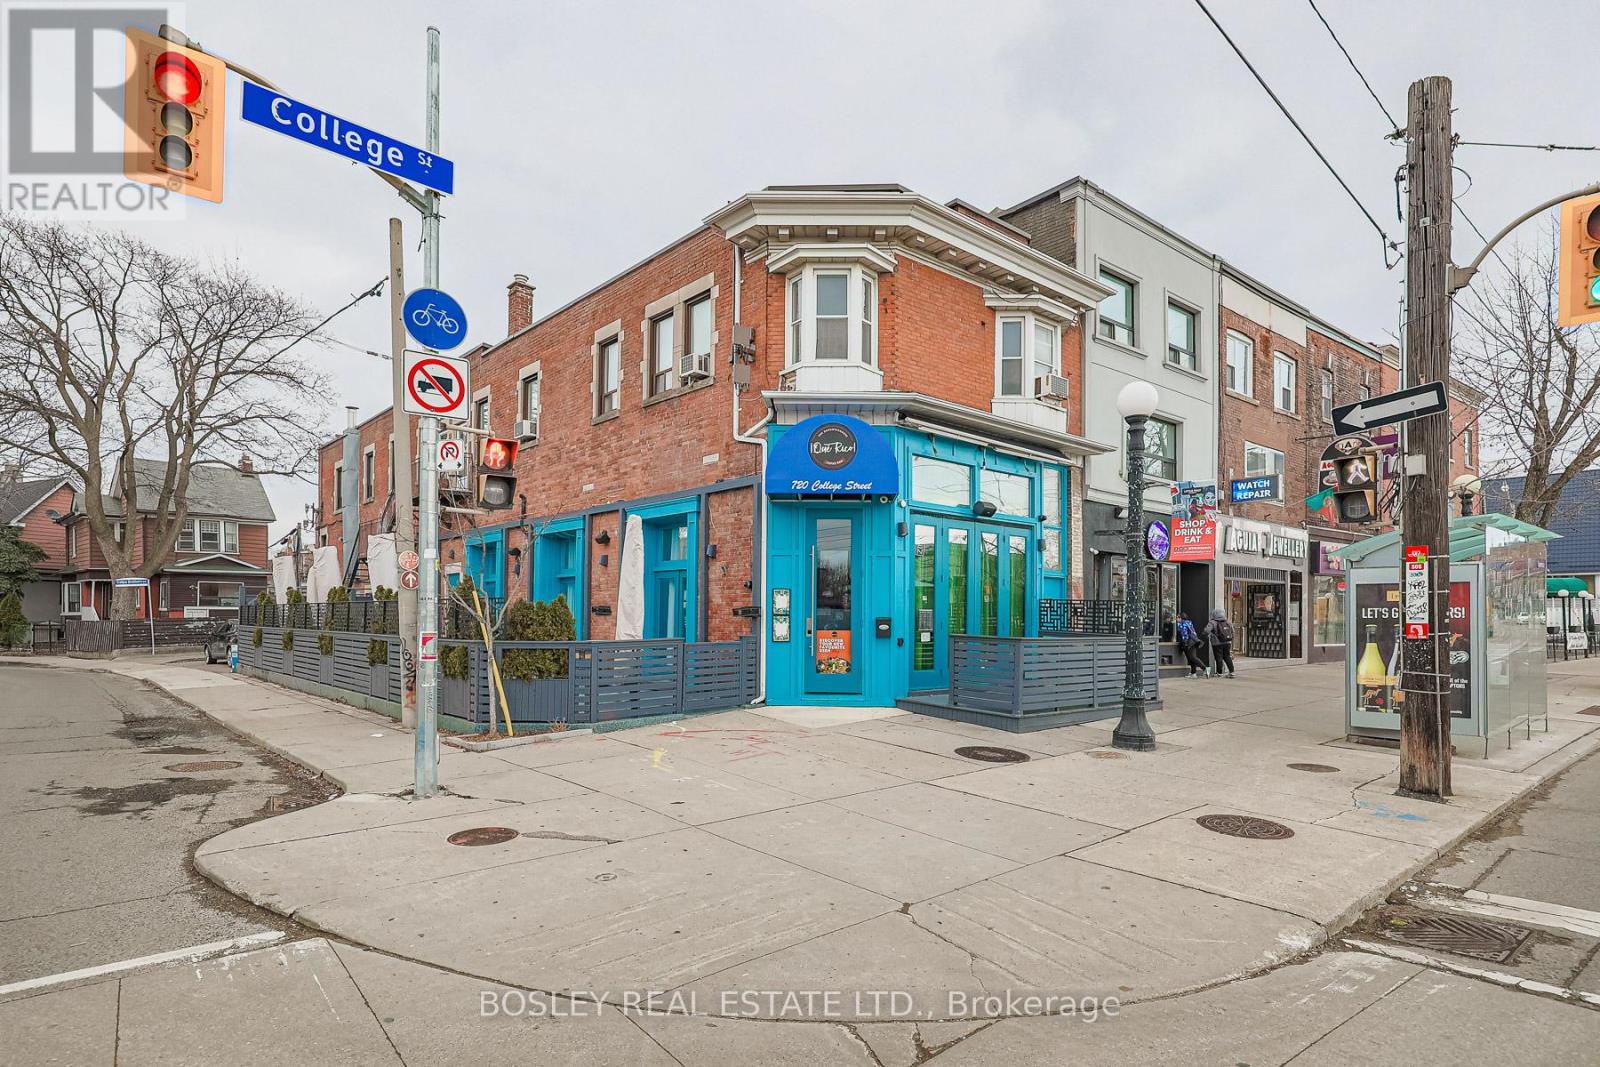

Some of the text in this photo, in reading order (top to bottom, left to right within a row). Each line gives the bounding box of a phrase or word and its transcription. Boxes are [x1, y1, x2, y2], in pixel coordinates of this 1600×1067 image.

[270, 97, 434, 170] College St
[791, 480, 873, 492] 720 College Street
[1237, 480, 1270, 490] WATCH
[1236, 490, 1271, 500] REPAIR
[1174, 527, 1213, 536] DRINK &
[1184, 536, 1201, 544] EAT
[1362, 607, 1389, 619] LET'S
